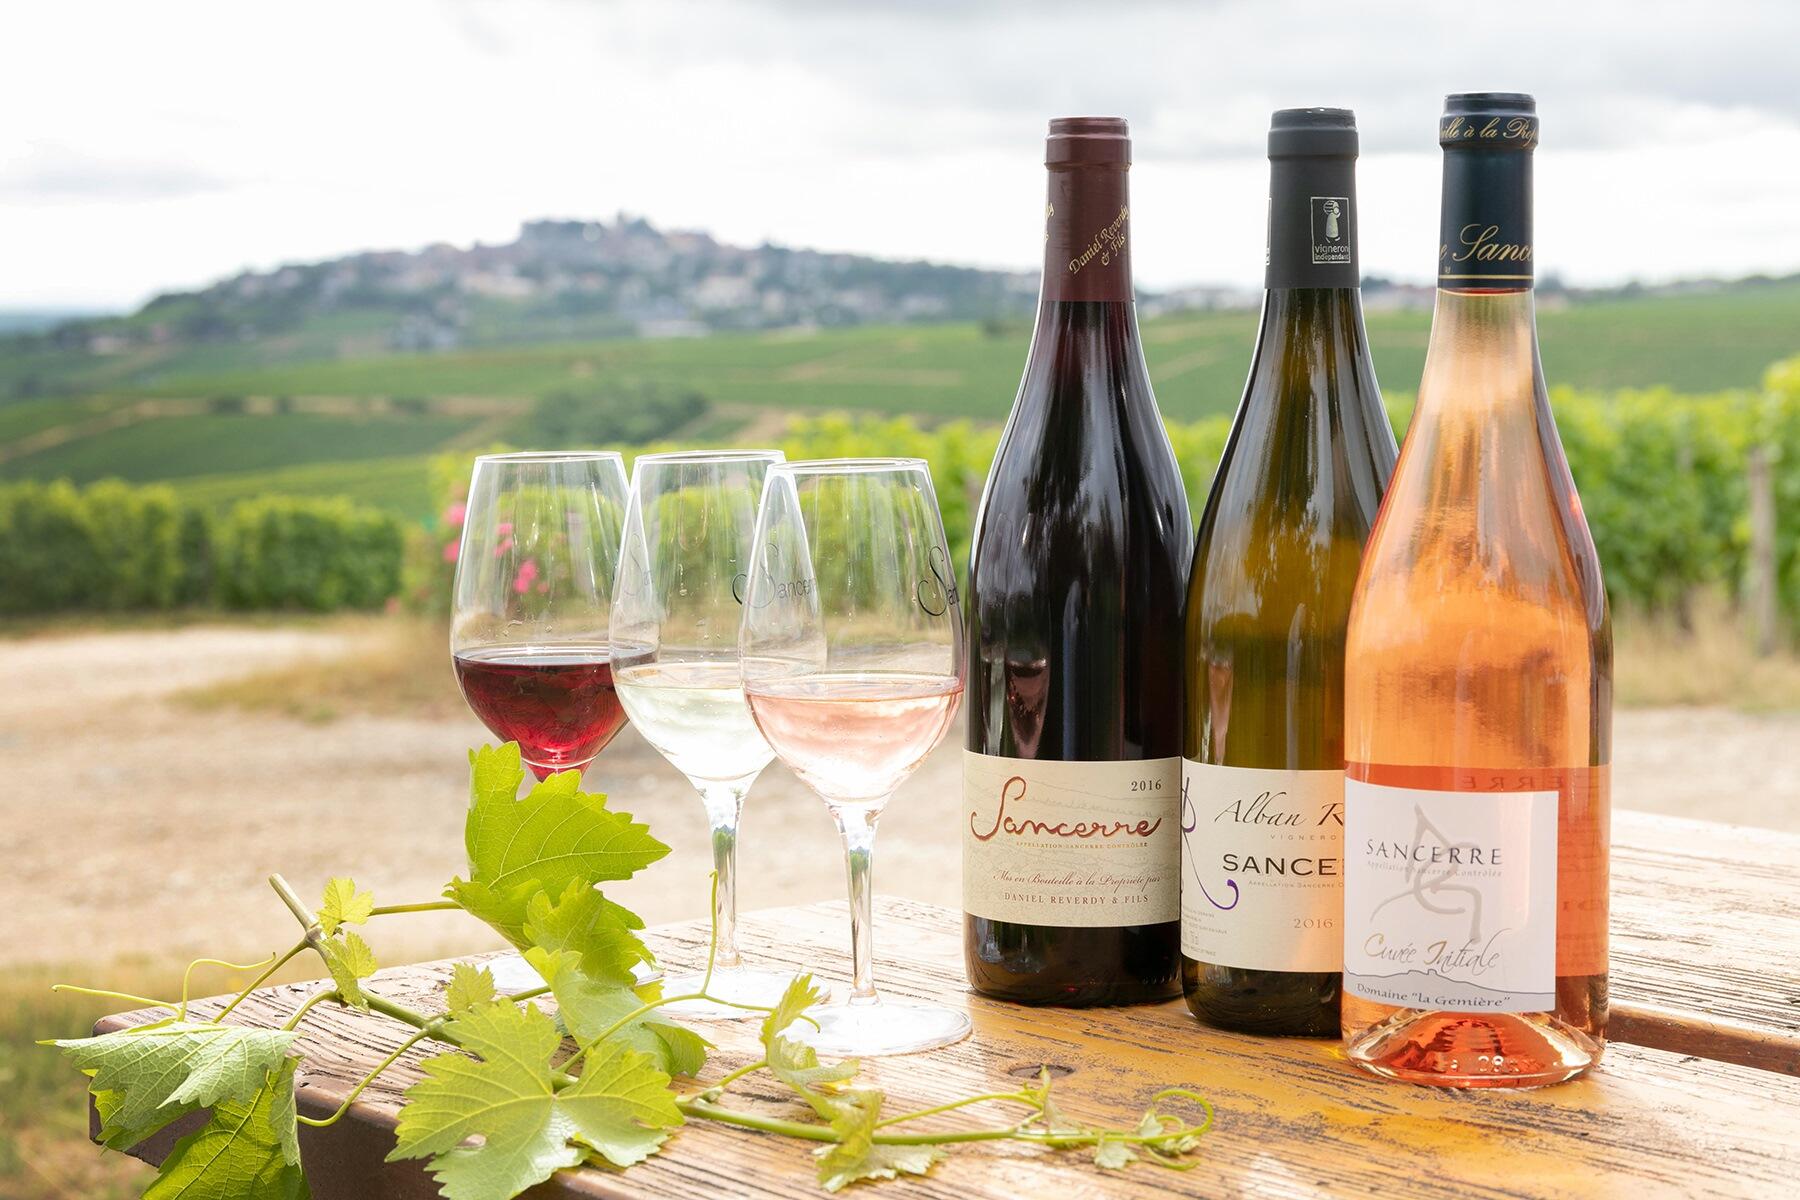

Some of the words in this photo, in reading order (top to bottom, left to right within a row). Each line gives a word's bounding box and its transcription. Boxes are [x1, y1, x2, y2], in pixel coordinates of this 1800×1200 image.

[1463, 125, 1475, 138] à
[1479, 116, 1501, 138] la
[1069, 234, 1103, 275] Daniel
[1100, 204, 1129, 244] Reverdy
[1101, 249, 1111, 266] &
[1110, 232, 1126, 257] Fils
[1452, 223, 1533, 262] Sanc
[1131, 779, 1162, 791] 2016
[970, 776, 1162, 841] Sancerre
[1214, 791, 1308, 826] Alban
[1366, 838, 1505, 865] SANCERRE
[1222, 853, 1344, 876] SANCE
[1027, 871, 1075, 886] Bouteille
[1085, 871, 1097, 885] la
[1141, 876, 1161, 893] par
[1004, 892, 1044, 903] DANIEL
[1050, 895, 1106, 905] REVERDY
[1124, 895, 1150, 904] FILS
[1293, 918, 1334, 929] 2016
[1364, 932, 1417, 964] Cuvée
[1357, 983, 1408, 1001] Domaine
